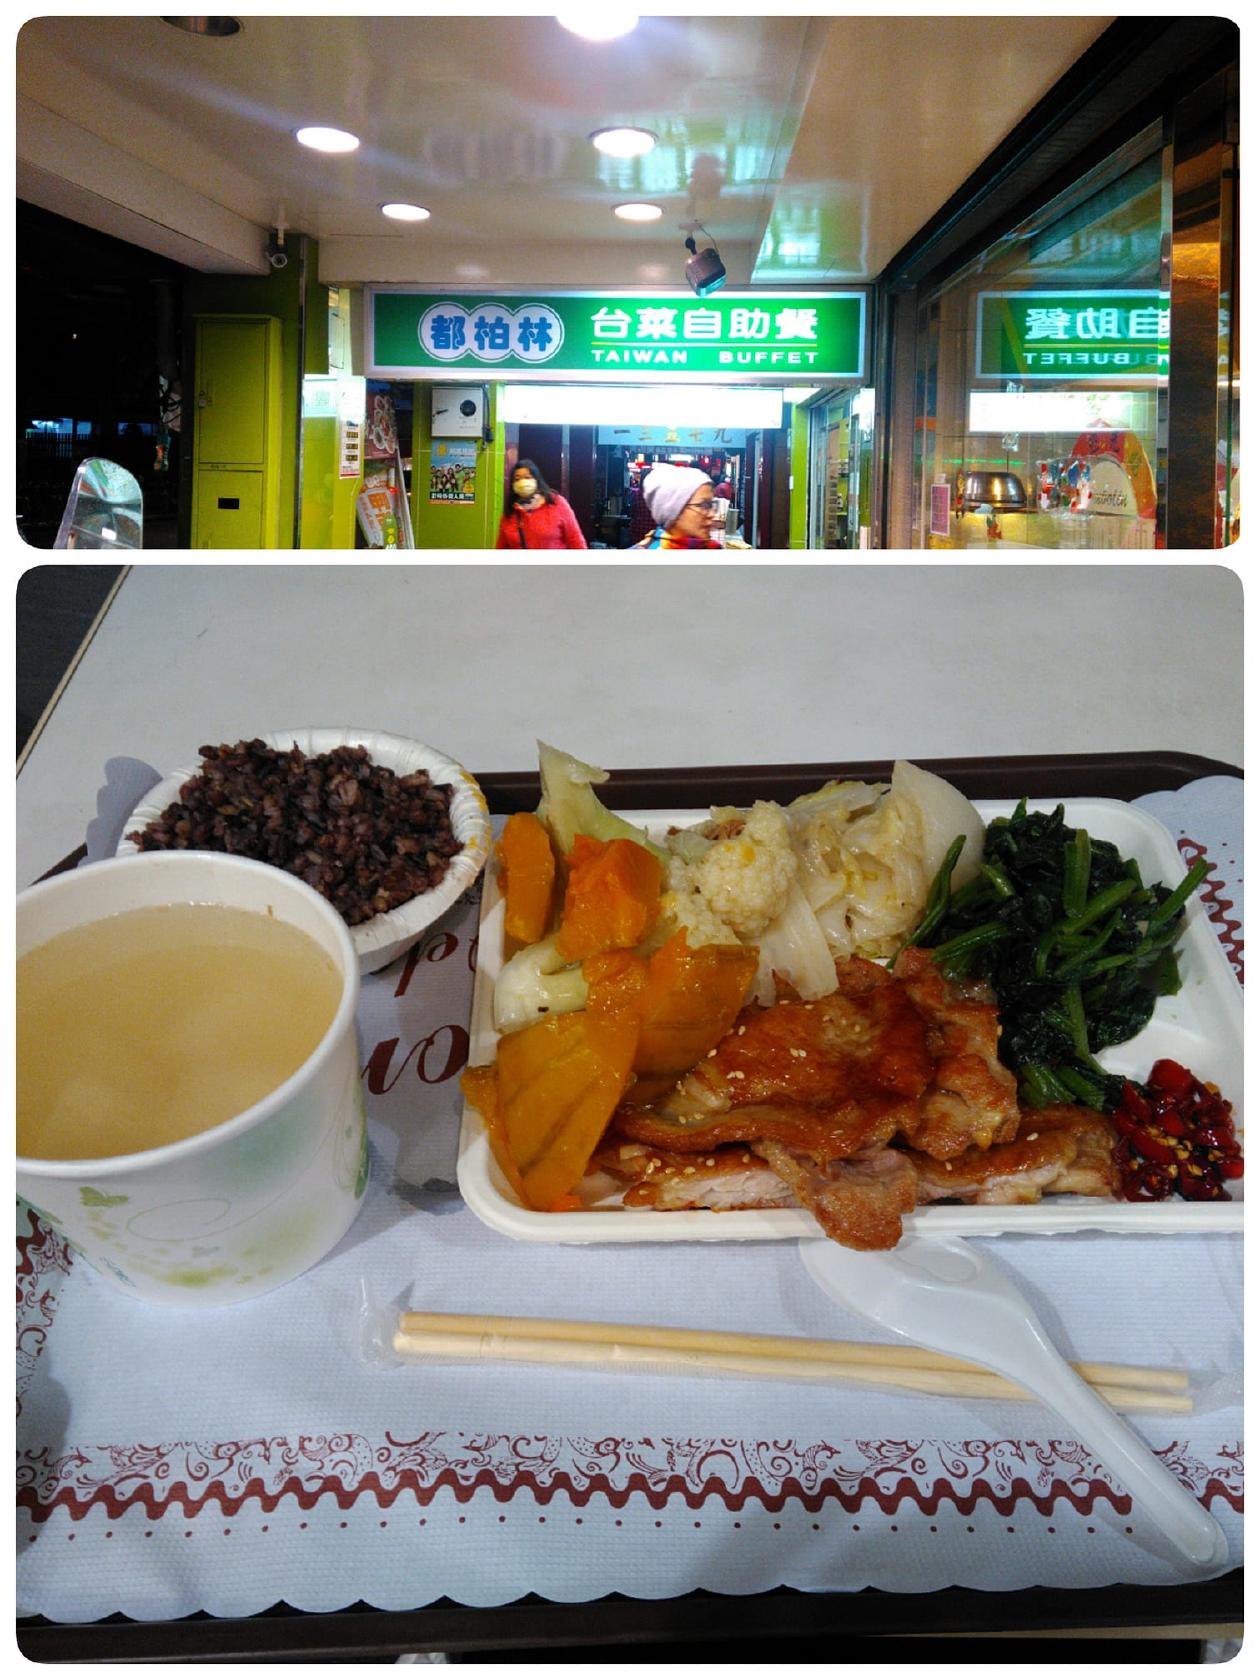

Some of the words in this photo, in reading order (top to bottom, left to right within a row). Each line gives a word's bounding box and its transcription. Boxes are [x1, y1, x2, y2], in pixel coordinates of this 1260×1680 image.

[430, 315, 554, 351] 都柏林
[590, 307, 818, 340] 台菜自助餐
[591, 349, 688, 364] TAIWAN
[718, 351, 819, 364] BUFFET
